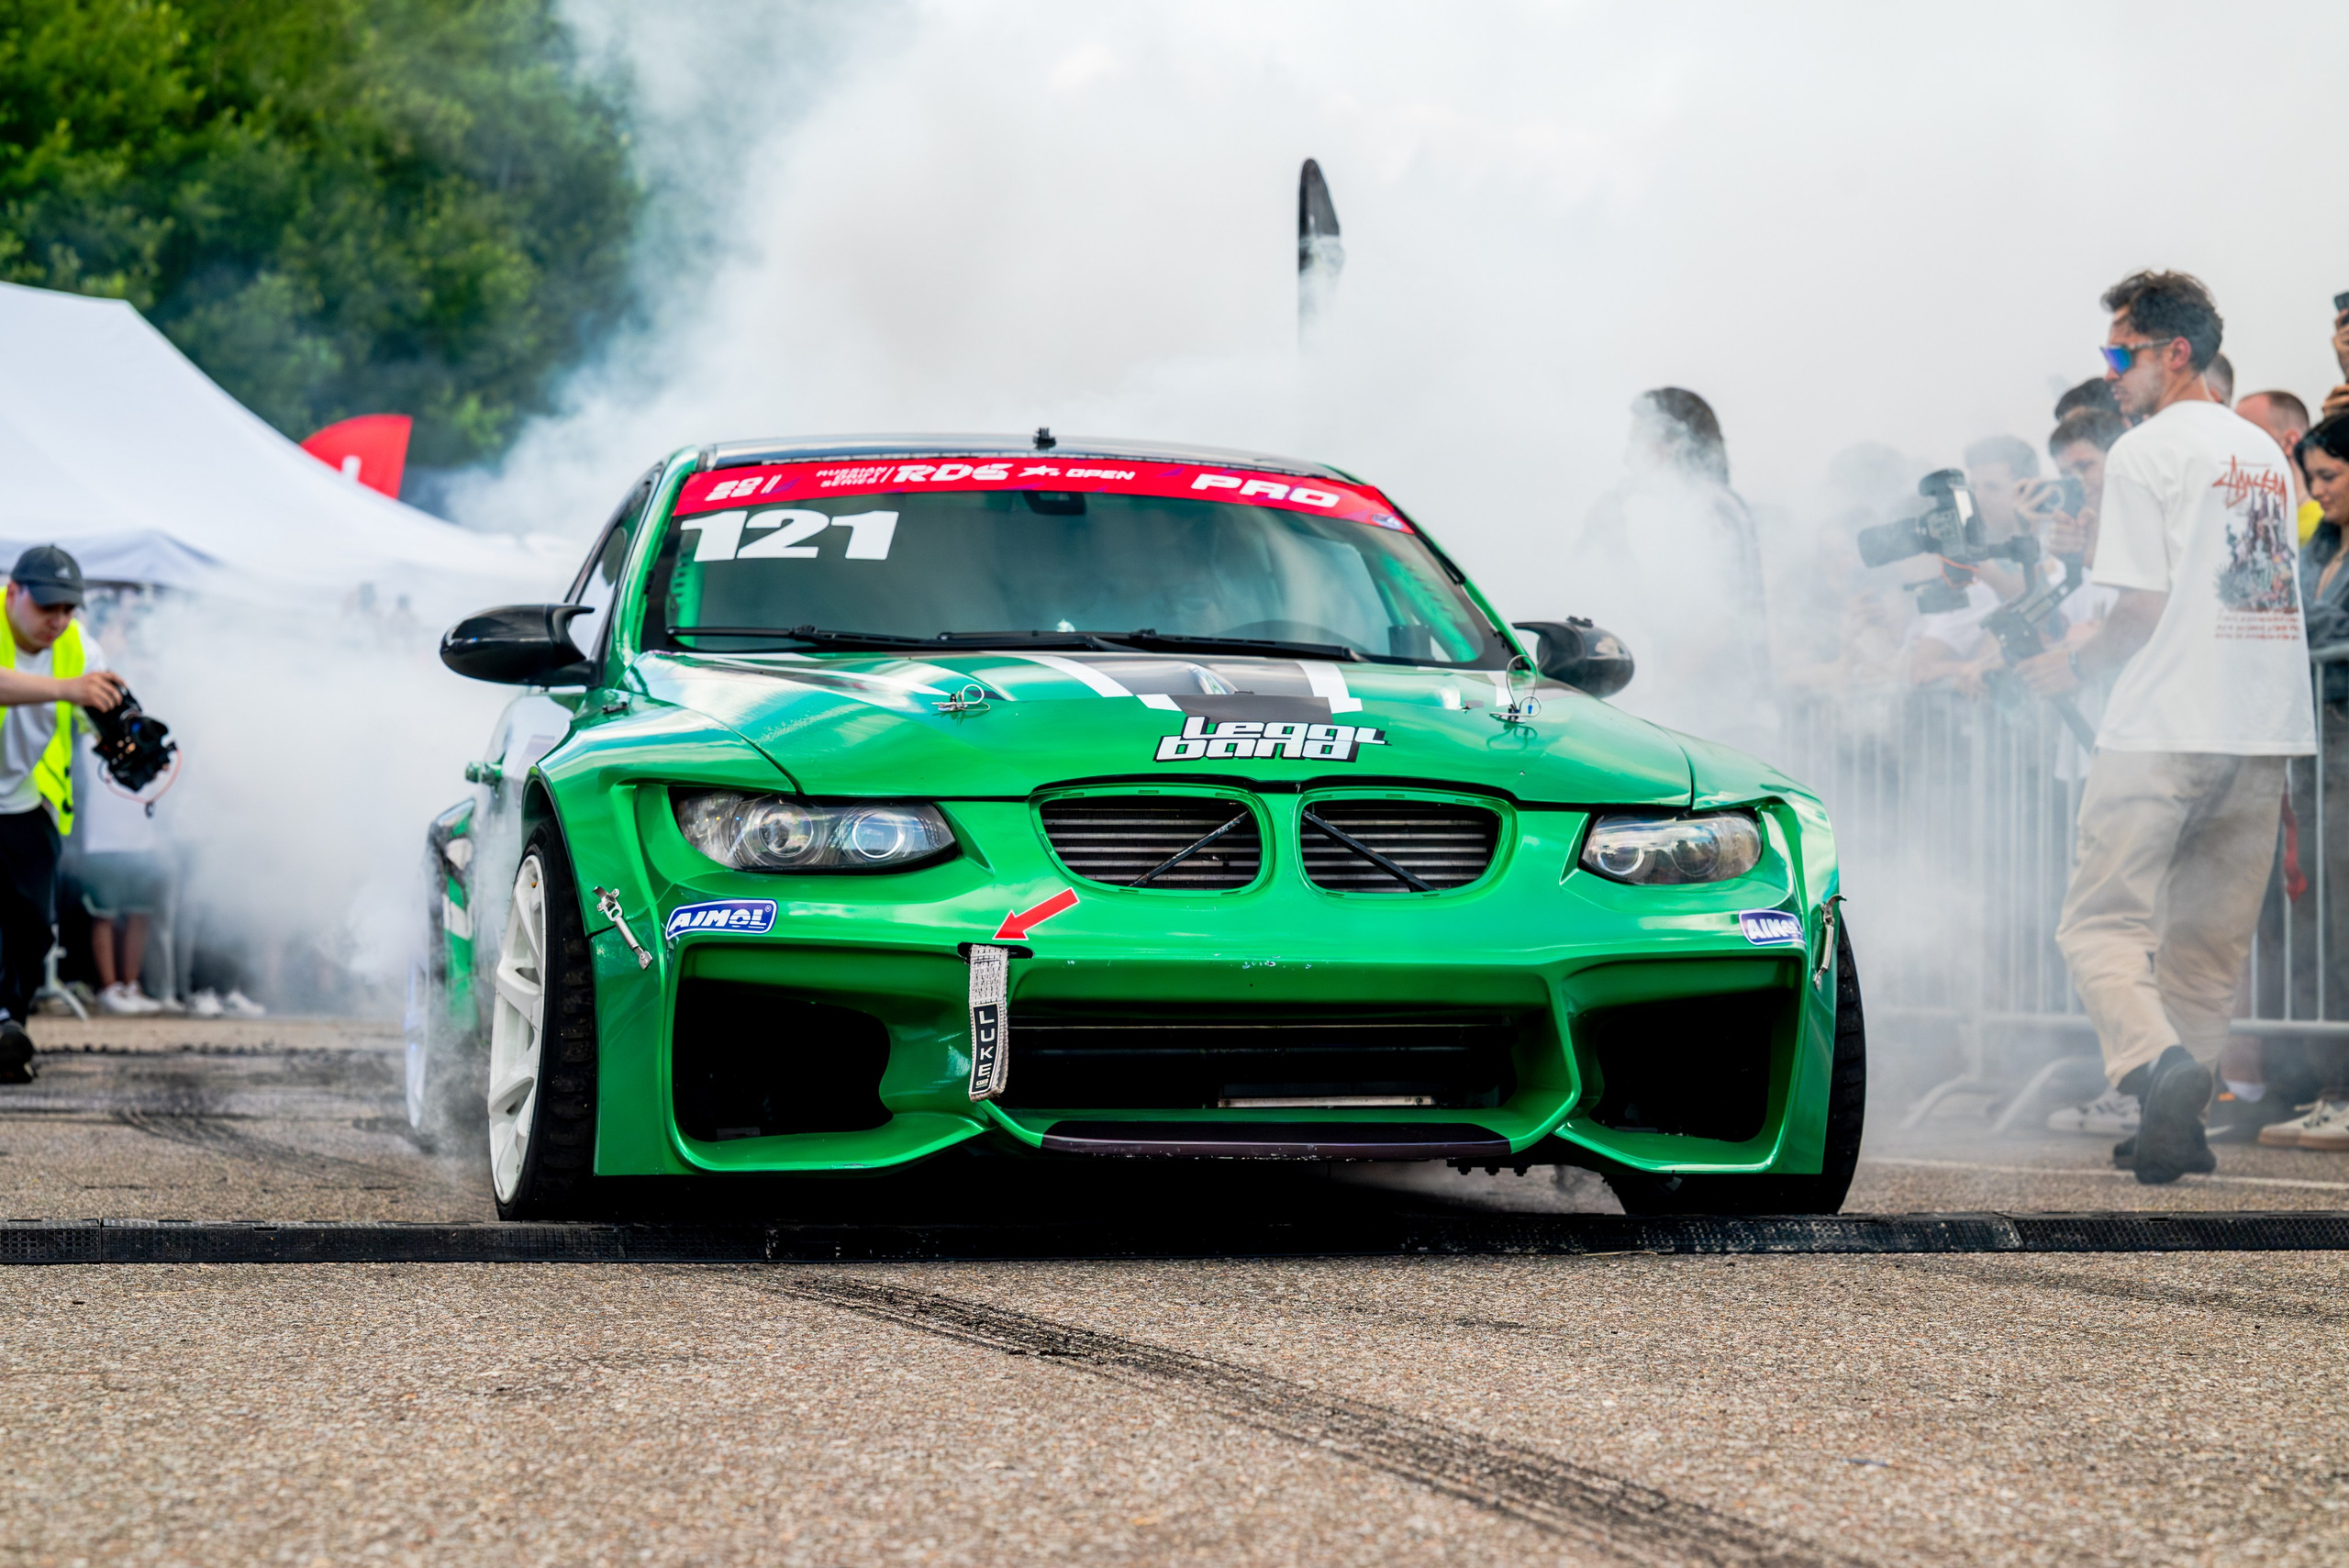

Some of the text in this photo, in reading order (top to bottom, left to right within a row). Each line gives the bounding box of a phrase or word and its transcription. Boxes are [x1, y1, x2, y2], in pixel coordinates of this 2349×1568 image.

[893, 463, 1136, 483] RDS OPEN
[1191, 473, 1341, 508] PRO
[680, 508, 900, 562] 121
[977, 1010, 995, 1076] LUKE
